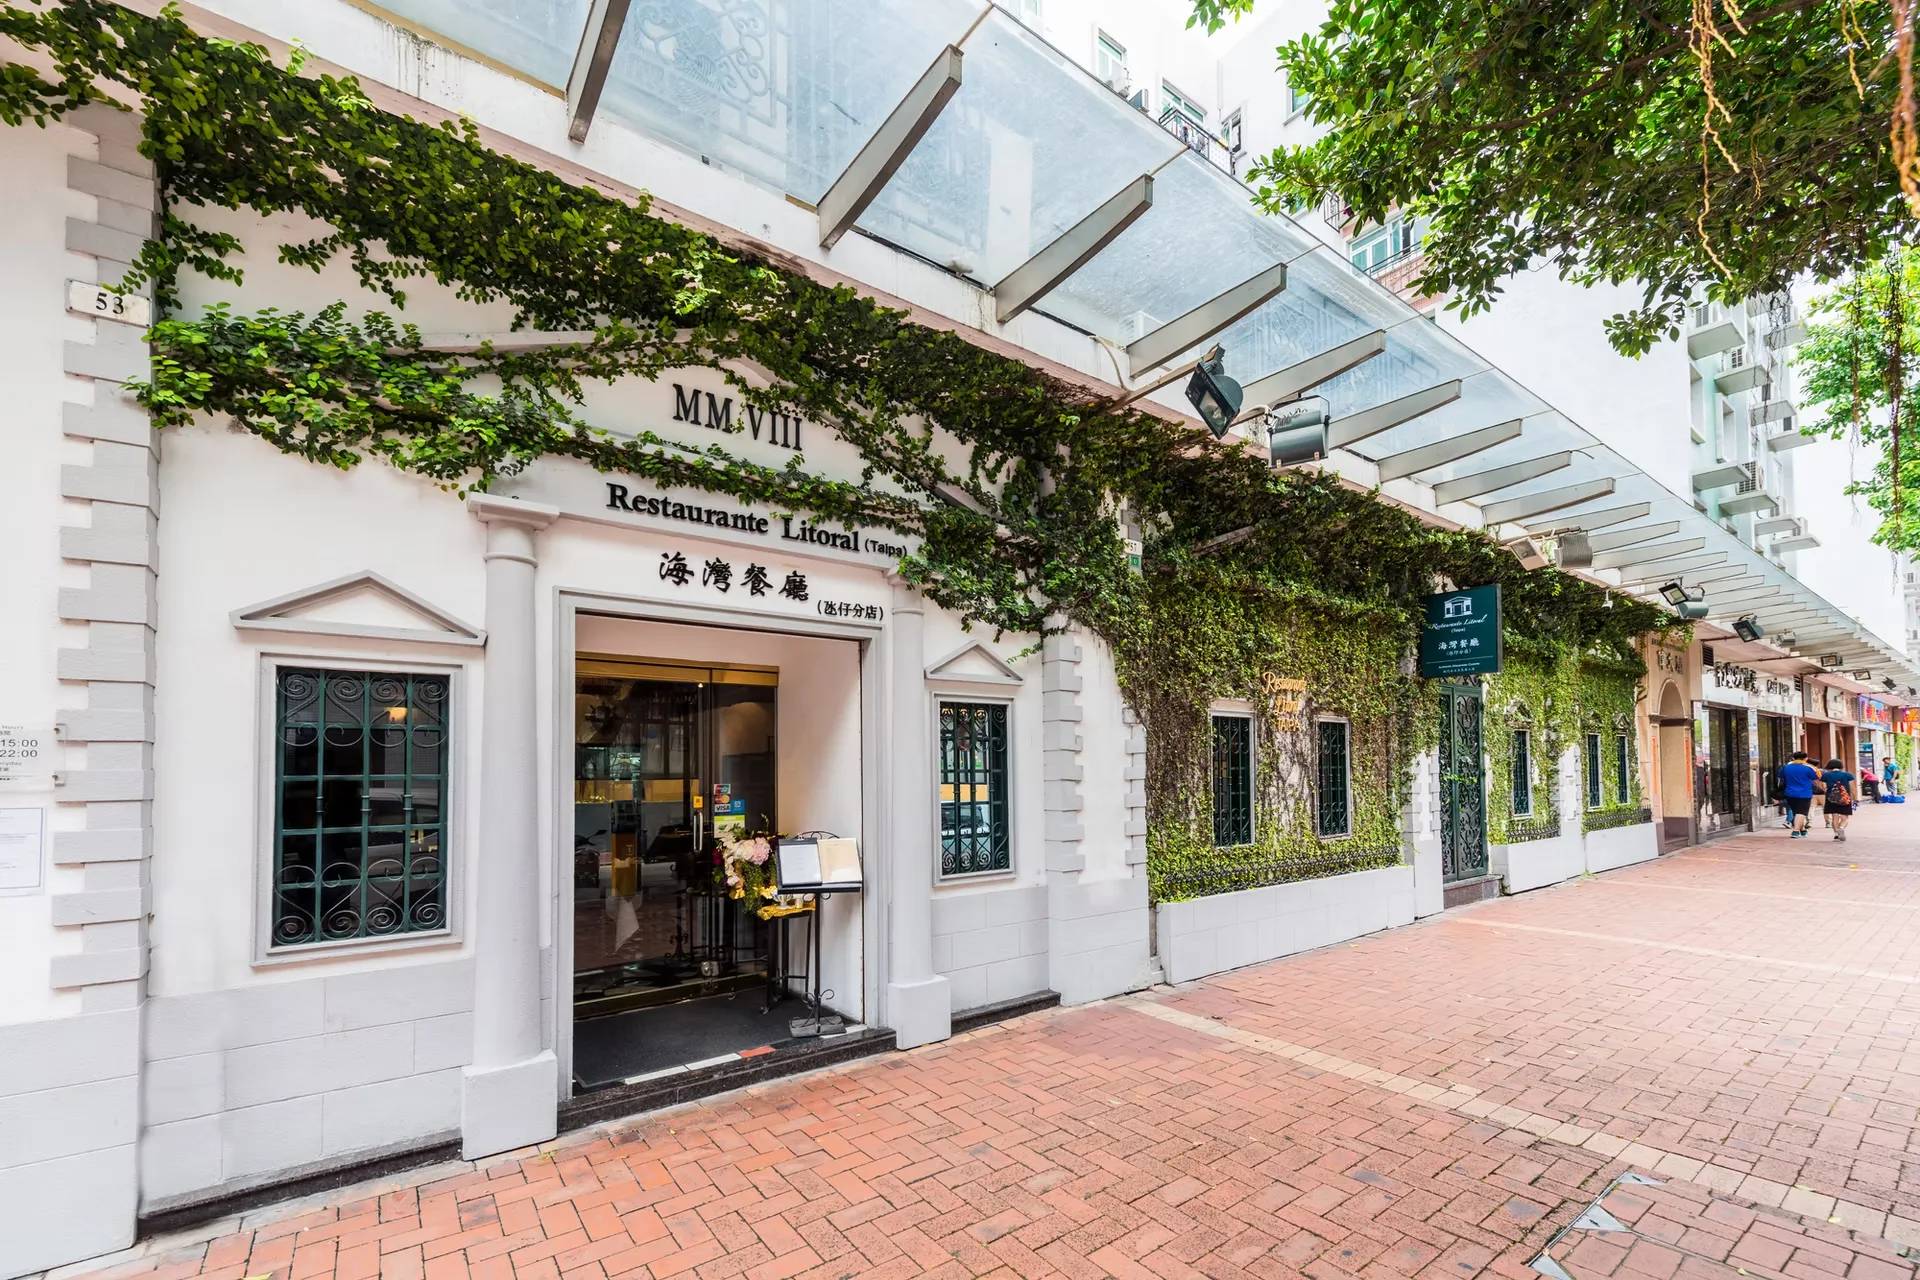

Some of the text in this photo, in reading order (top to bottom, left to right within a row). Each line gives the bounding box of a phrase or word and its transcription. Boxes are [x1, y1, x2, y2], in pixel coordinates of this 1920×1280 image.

[95, 292, 124, 314] 53
[606, 482, 769, 534] Restaurante
[781, 516, 860, 552] Litoral
[659, 551, 809, 601] 海灣餐廳
